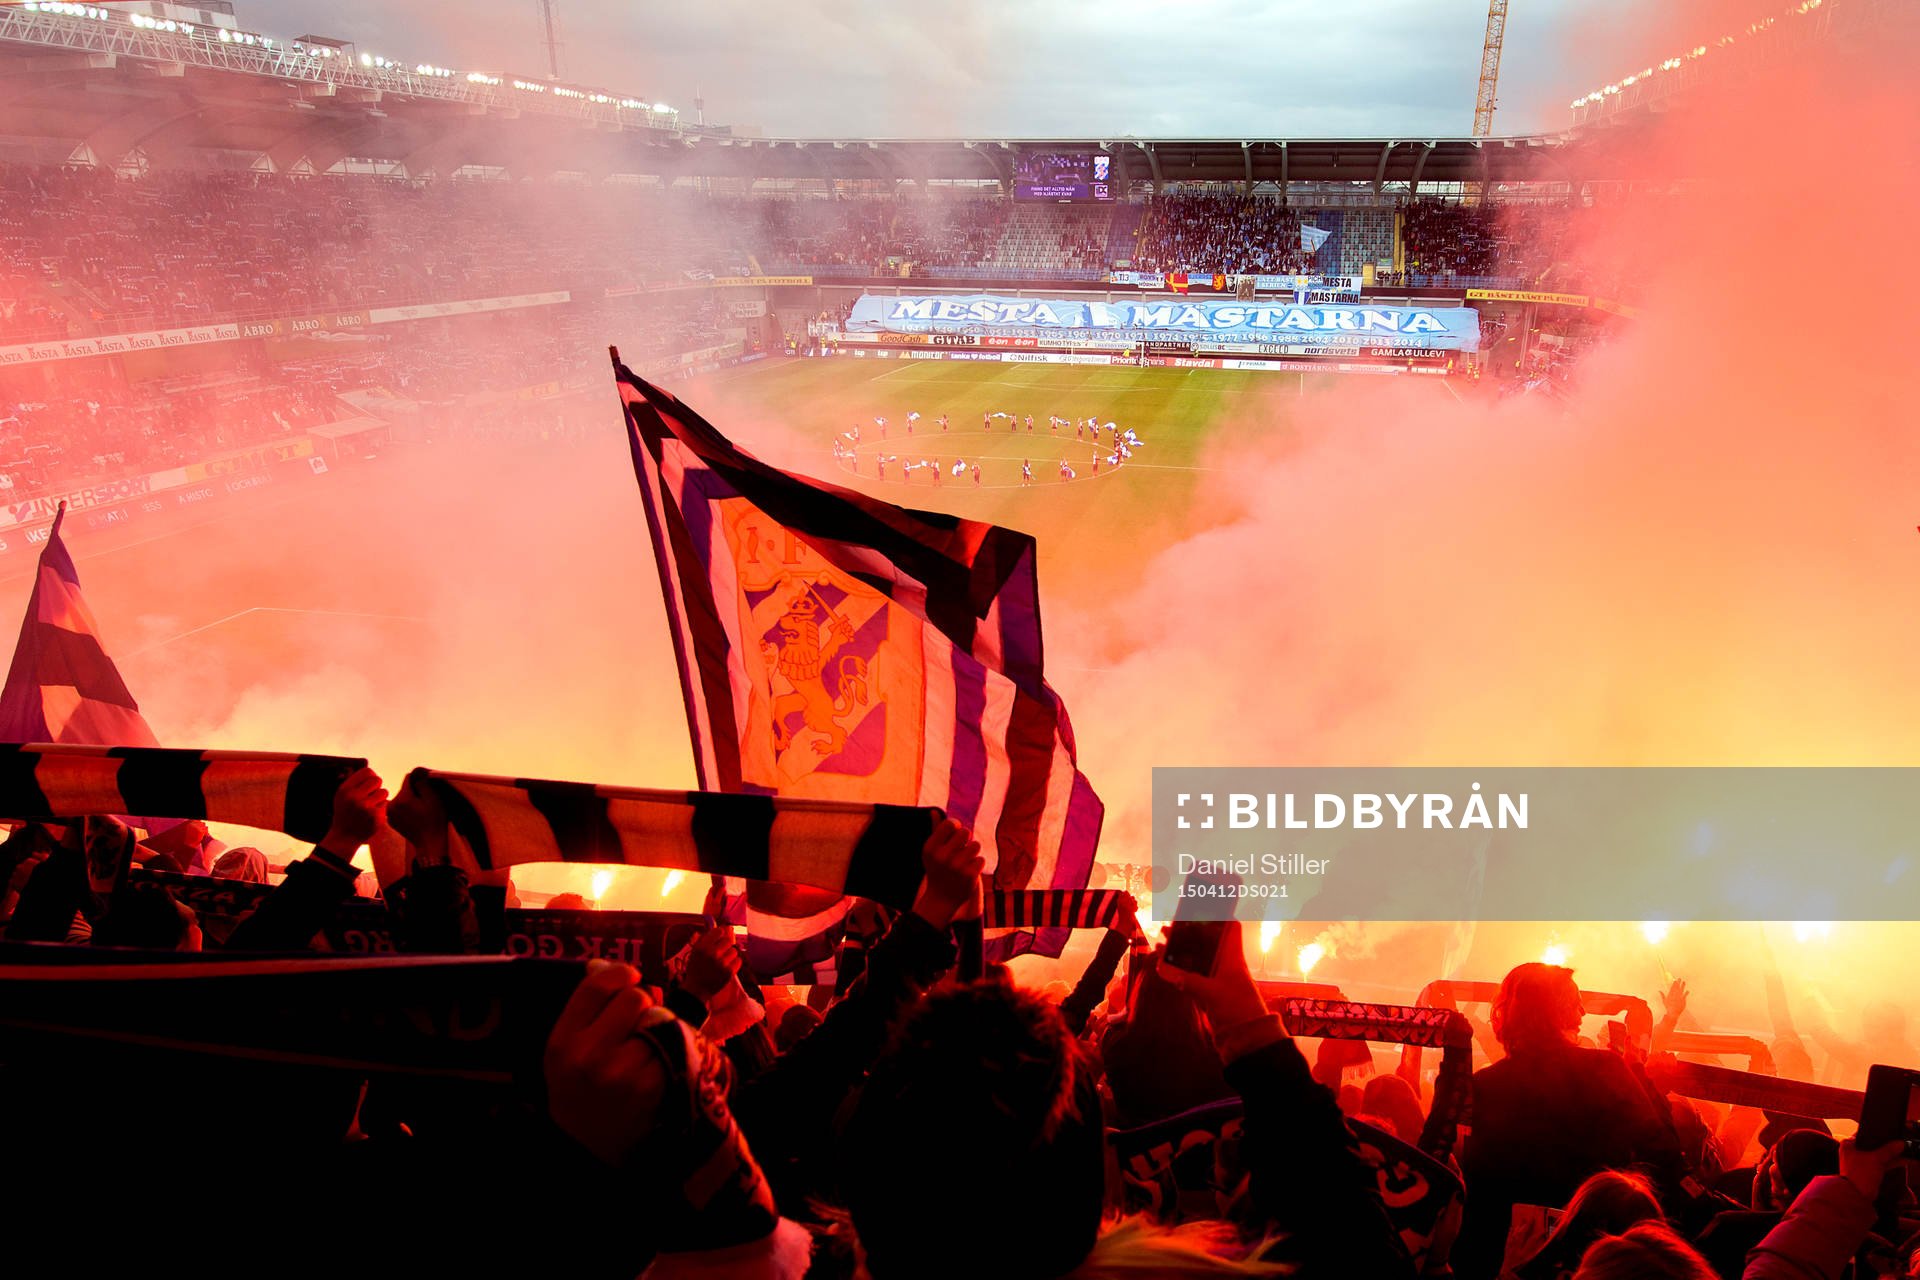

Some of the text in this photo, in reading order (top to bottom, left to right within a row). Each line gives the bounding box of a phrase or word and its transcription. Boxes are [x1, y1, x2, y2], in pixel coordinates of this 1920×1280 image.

[1322, 277, 1352, 288] MESTA
[889, 299, 1451, 334] MESTA MÄSTARNA
[880, 335, 921, 344] GoodCash
[933, 335, 975, 344] GITAB
[1095, 331, 1120, 340] 1970
[1211, 334, 1238, 342] 1977
[1271, 334, 1298, 343] 1988
[1301, 335, 1328, 343] 2004
[1332, 335, 1359, 345] 2010
[1393, 337, 1422, 347] 2014
[1017, 353, 1048, 361] Nilfisk
[1371, 348, 1445, 358] GAMLA ULLEVI
[1174, 358, 1215, 368] Stavdal
